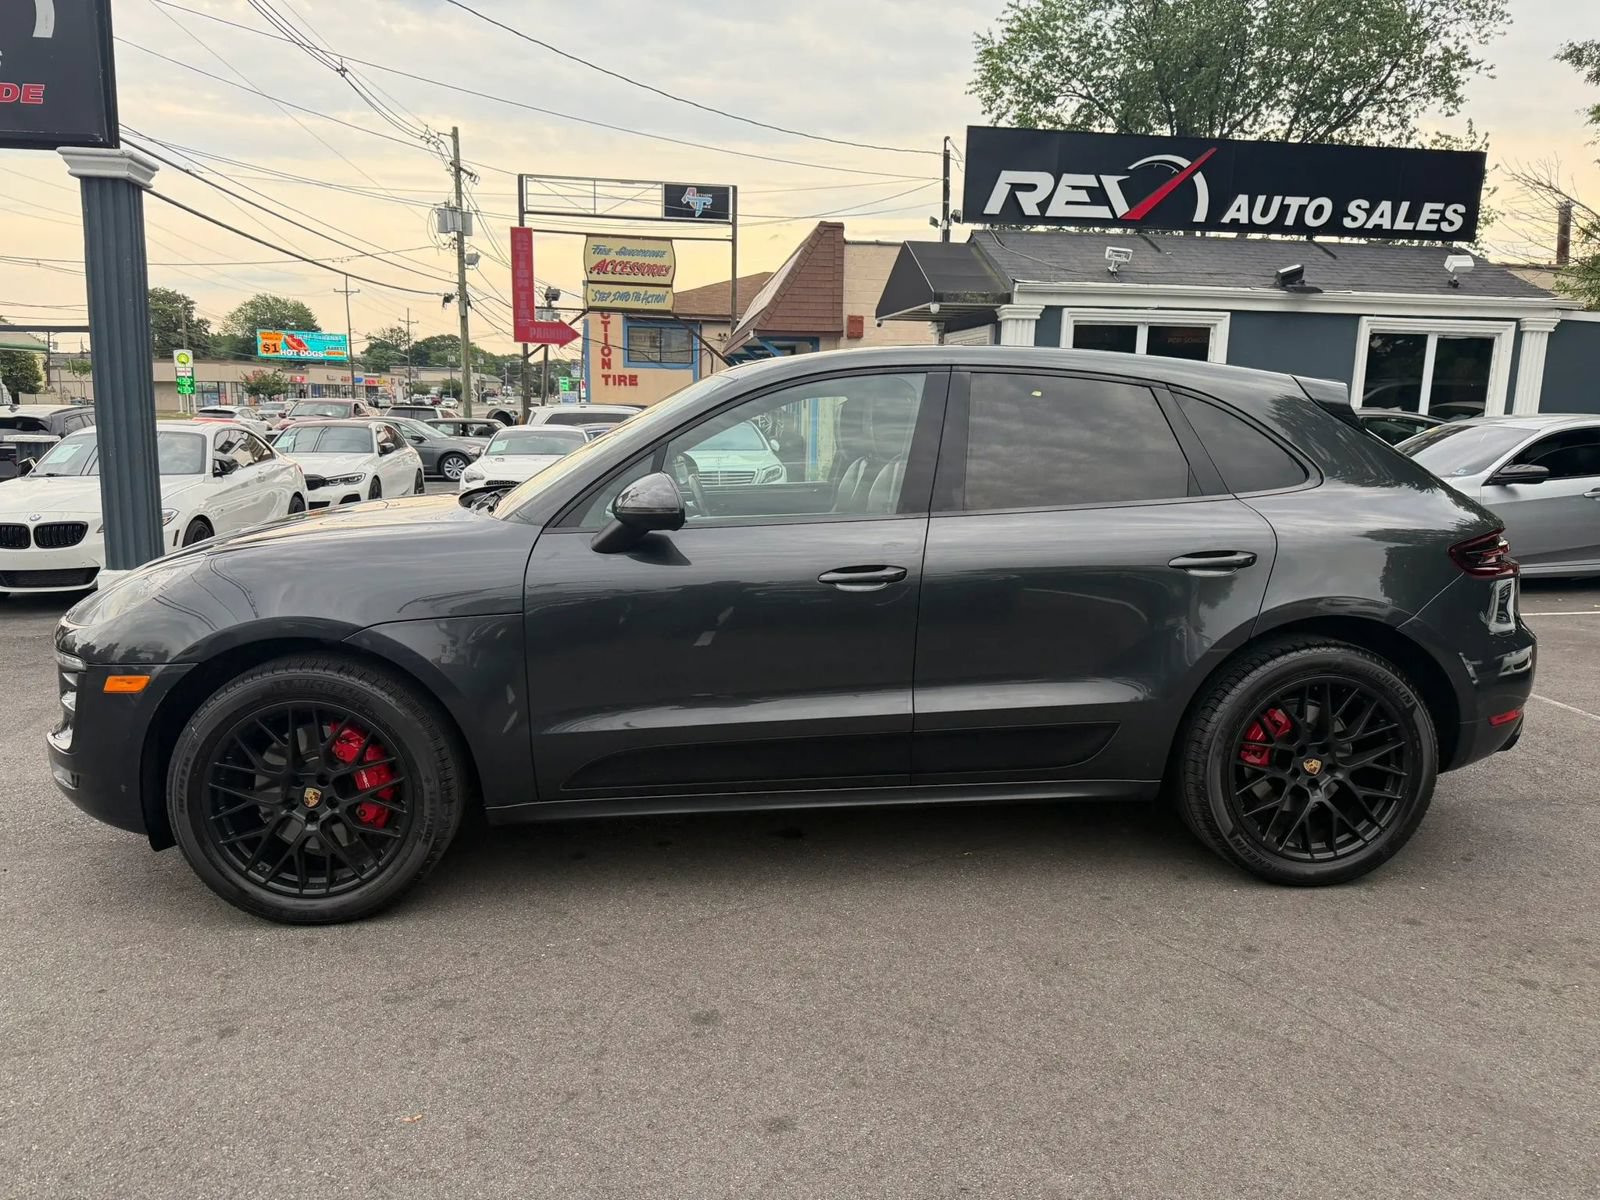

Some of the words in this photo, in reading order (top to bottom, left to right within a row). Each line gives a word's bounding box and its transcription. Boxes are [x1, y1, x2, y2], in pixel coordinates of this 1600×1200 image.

[1220, 193, 1333, 228] AUTO
[1342, 198, 1466, 233] SALES
[262, 342, 280, 354] $1
[601, 374, 639, 387] TIRE
